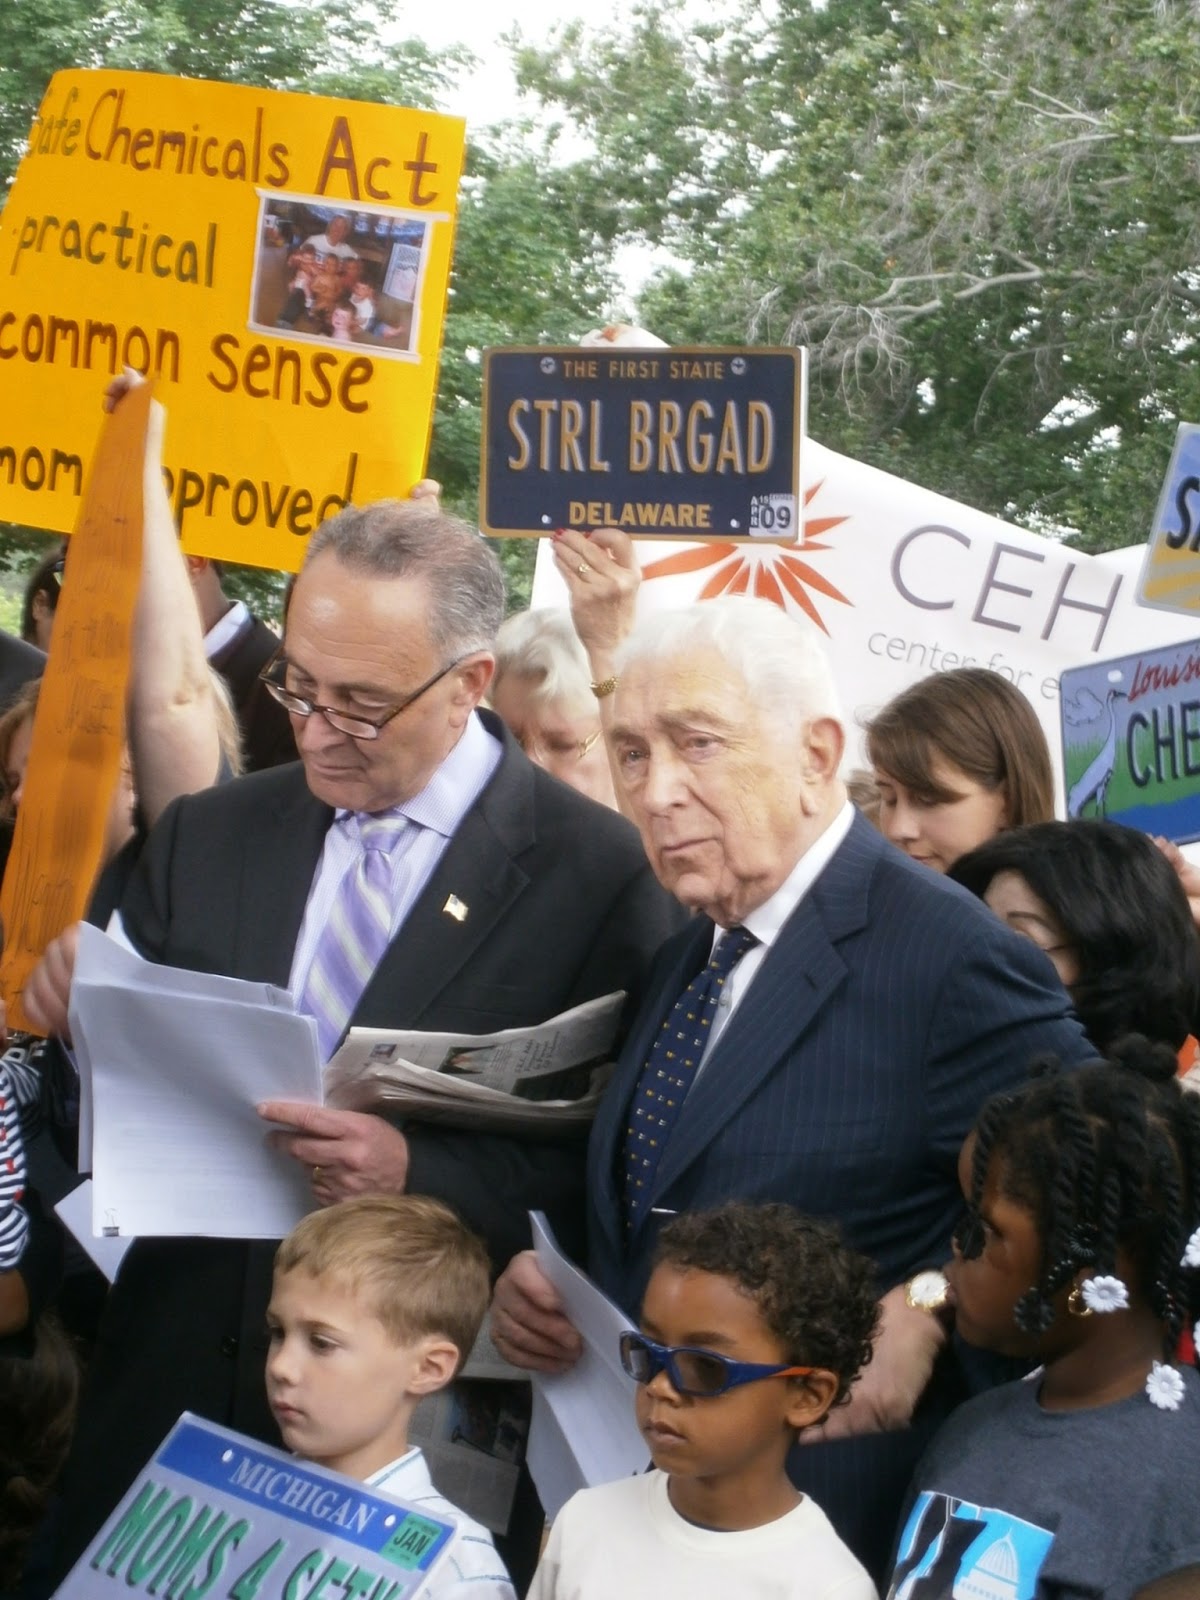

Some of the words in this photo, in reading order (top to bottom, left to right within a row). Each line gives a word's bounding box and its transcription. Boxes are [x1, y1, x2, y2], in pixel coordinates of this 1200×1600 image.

[85, 88, 291, 187] Chemicals
[315, 115, 439, 206] Act
[11, 210, 217, 287] practical
[0, 310, 181, 384] common
[207, 332, 375, 414] sense
[563, 360, 598, 378] THE
[609, 360, 660, 379] FIRST
[669, 361, 724, 380] STATE
[507, 397, 611, 473] STRL
[629, 399, 775, 474] BRGAD
[160, 452, 358, 540] proved
[569, 502, 713, 528] DELAWARE
[760, 506, 791, 529] 09
[1165, 475, 1200, 553] S
[890, 524, 1124, 652] CEH
[868, 632, 977, 673] center
[986, 653, 1033, 692] for
[228, 1457, 379, 1534] MICHIGAN
[90, 1479, 253, 1600] MOMS
[393, 1528, 431, 1557] JAN
